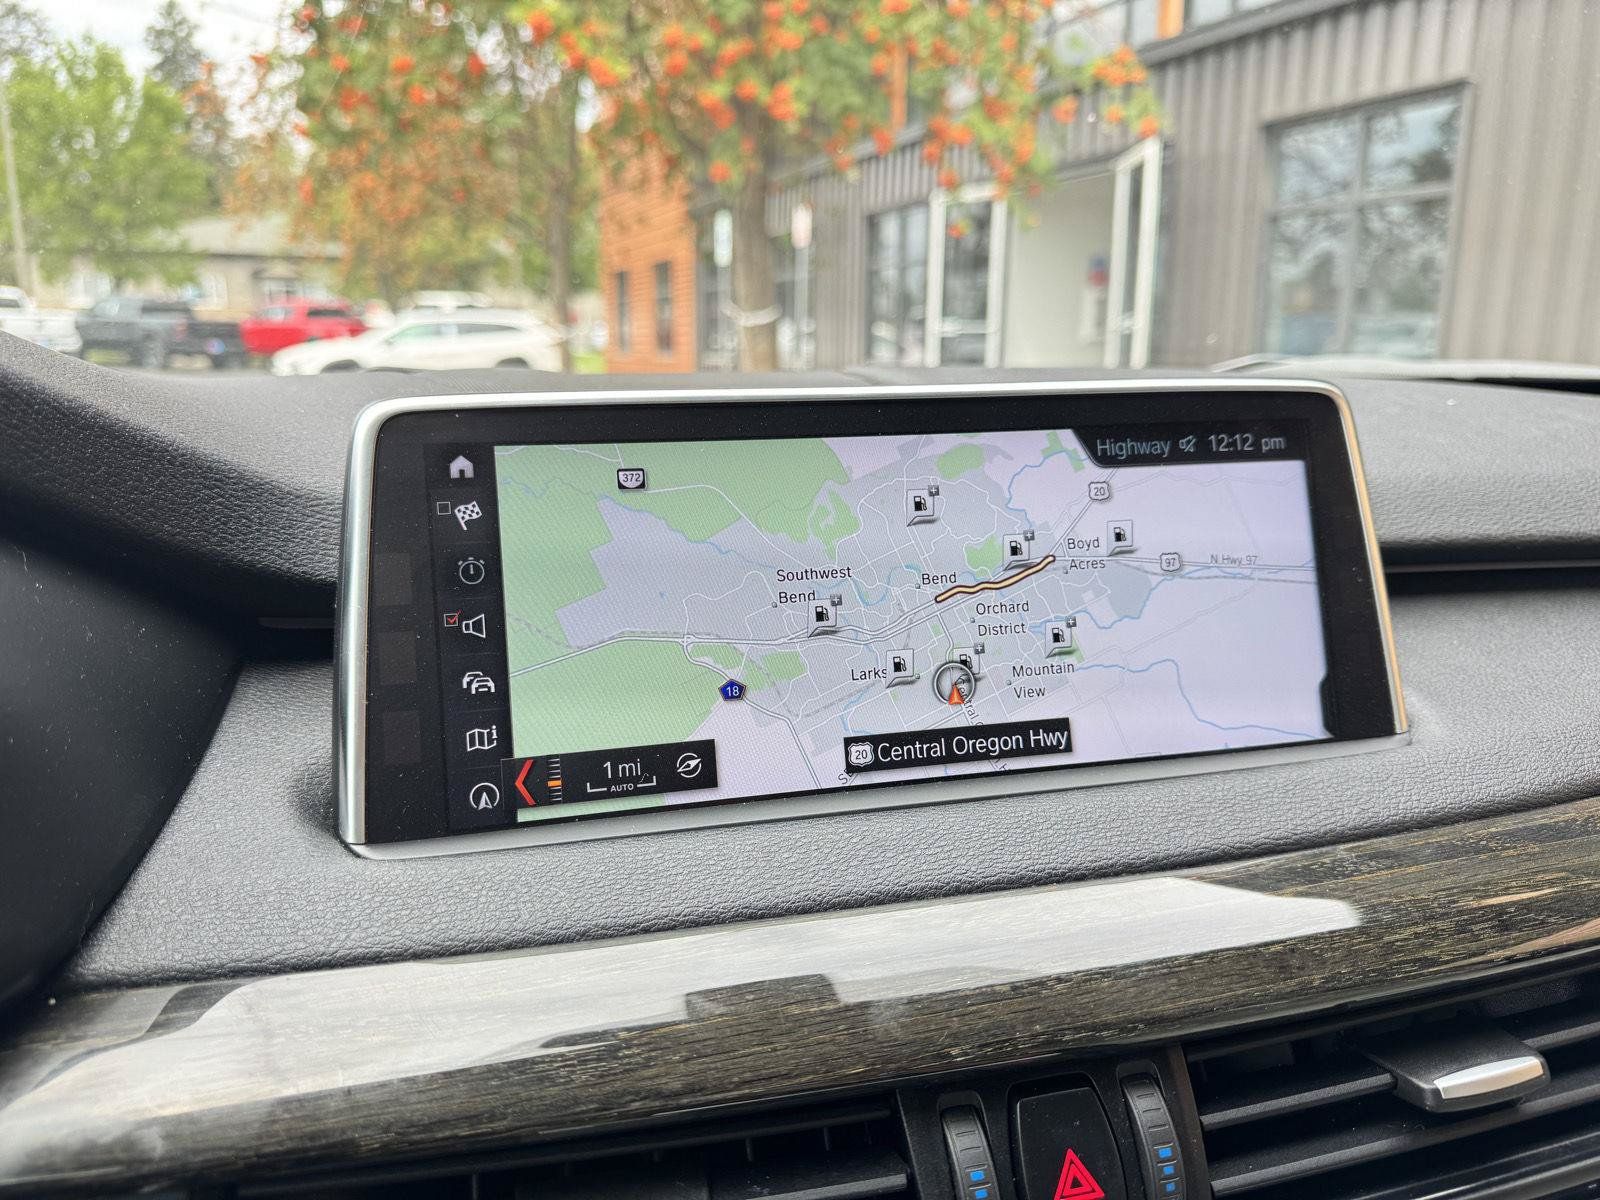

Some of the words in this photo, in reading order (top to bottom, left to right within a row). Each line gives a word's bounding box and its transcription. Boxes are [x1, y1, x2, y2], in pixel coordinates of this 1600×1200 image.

[1096, 438, 1171, 460] Highway
[1208, 434, 1254, 452] 12:12
[1261, 436, 1286, 453] pm
[622, 472, 641, 483] 372
[1094, 486, 1105, 497] 20
[1067, 536, 1100, 552] Boyd
[1069, 557, 1106, 571] Acres
[1165, 557, 1176, 568] 97
[1210, 554, 1218, 565] N
[1221, 554, 1242, 567] Hwy
[776, 566, 852, 583] Southwest
[921, 572, 957, 586] Bend
[778, 590, 816, 605] Bend
[975, 600, 1030, 616] Orchard
[977, 622, 1027, 637] District
[1012, 661, 1075, 678] Mountain
[726, 686, 739, 697] 18
[1013, 685, 1046, 700] View
[855, 749, 868, 760] 20
[877, 738, 946, 762] Central
[952, 731, 1024, 757] Oregon
[1029, 728, 1070, 750] Hwy
[603, 762, 612, 779] 1
[618, 758, 642, 778] mi
[610, 783, 634, 793] AUTO
